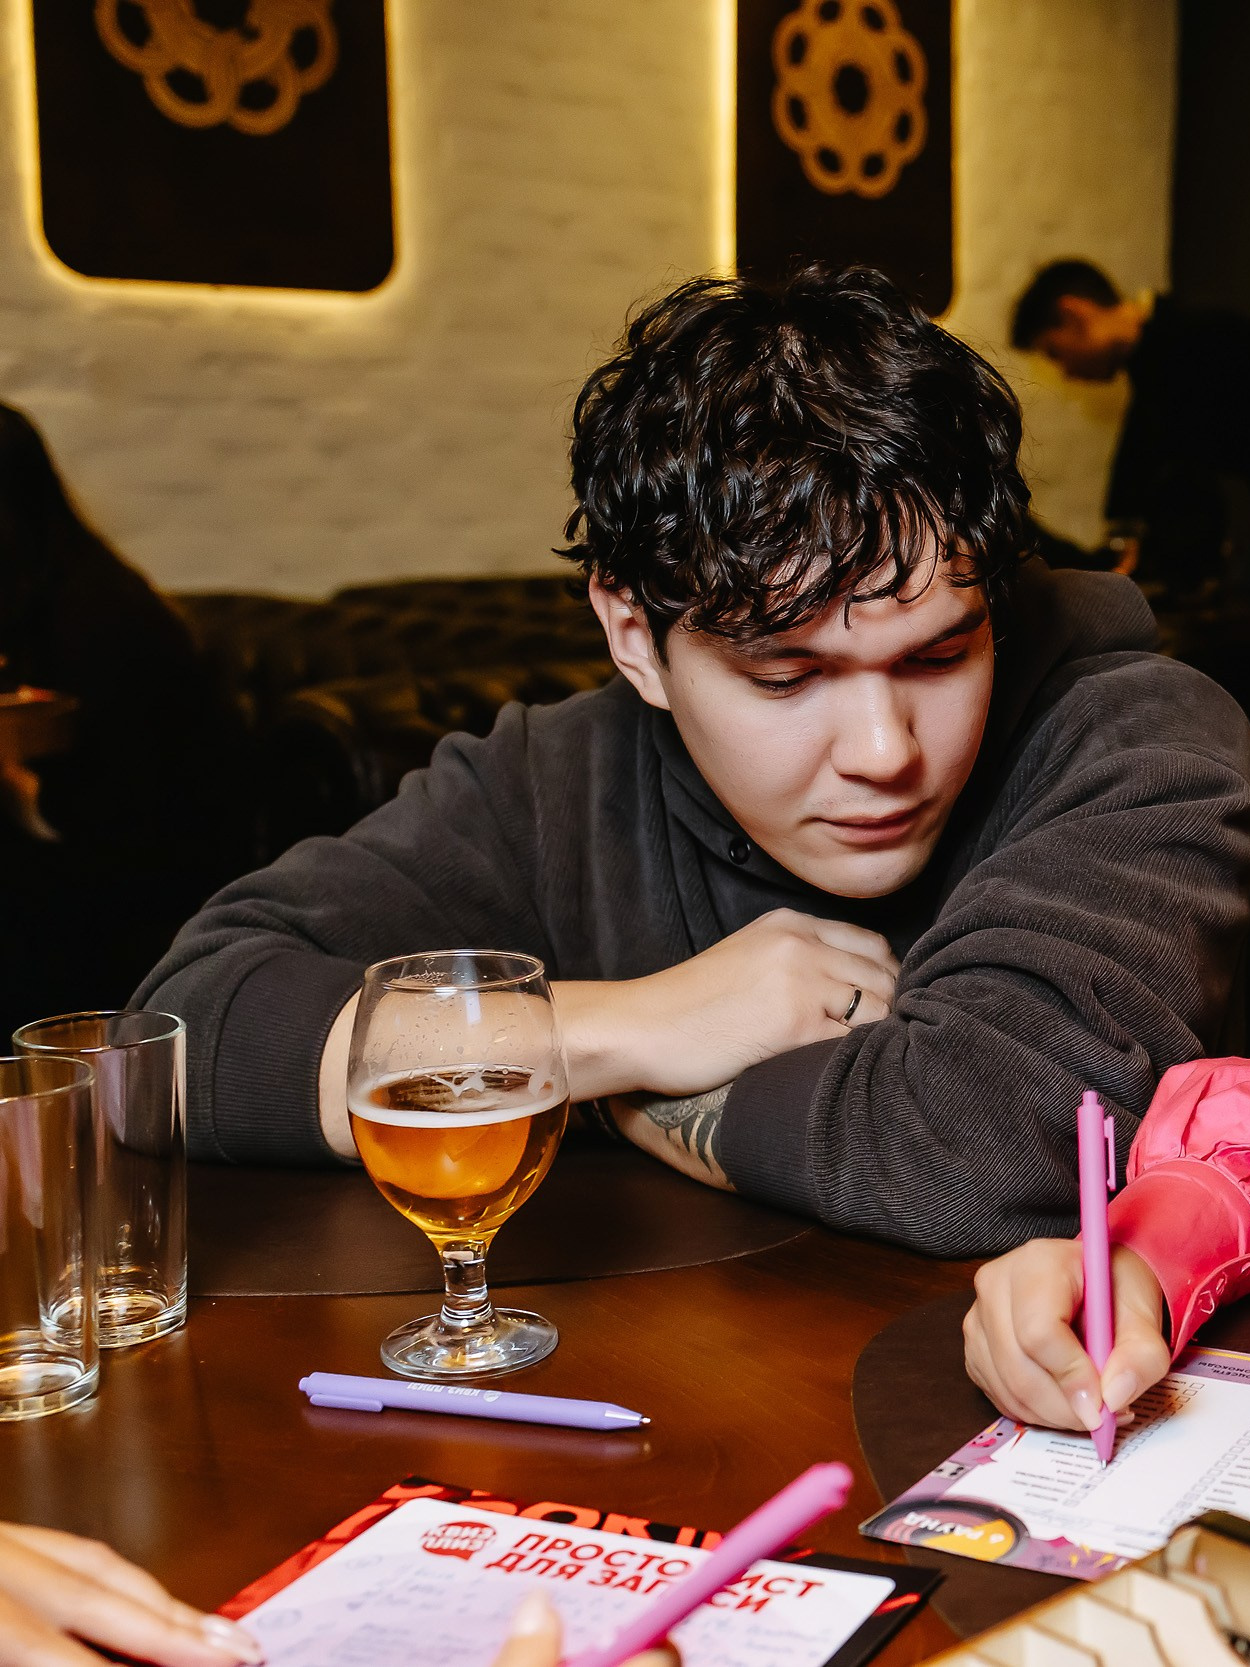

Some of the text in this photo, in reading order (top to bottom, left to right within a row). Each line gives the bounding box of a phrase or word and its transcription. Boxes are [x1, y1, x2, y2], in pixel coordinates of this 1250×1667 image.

[484, 1552, 584, 1580] ДЛЯ
[513, 1533, 825, 1598] ПРОСТО ИСТ
